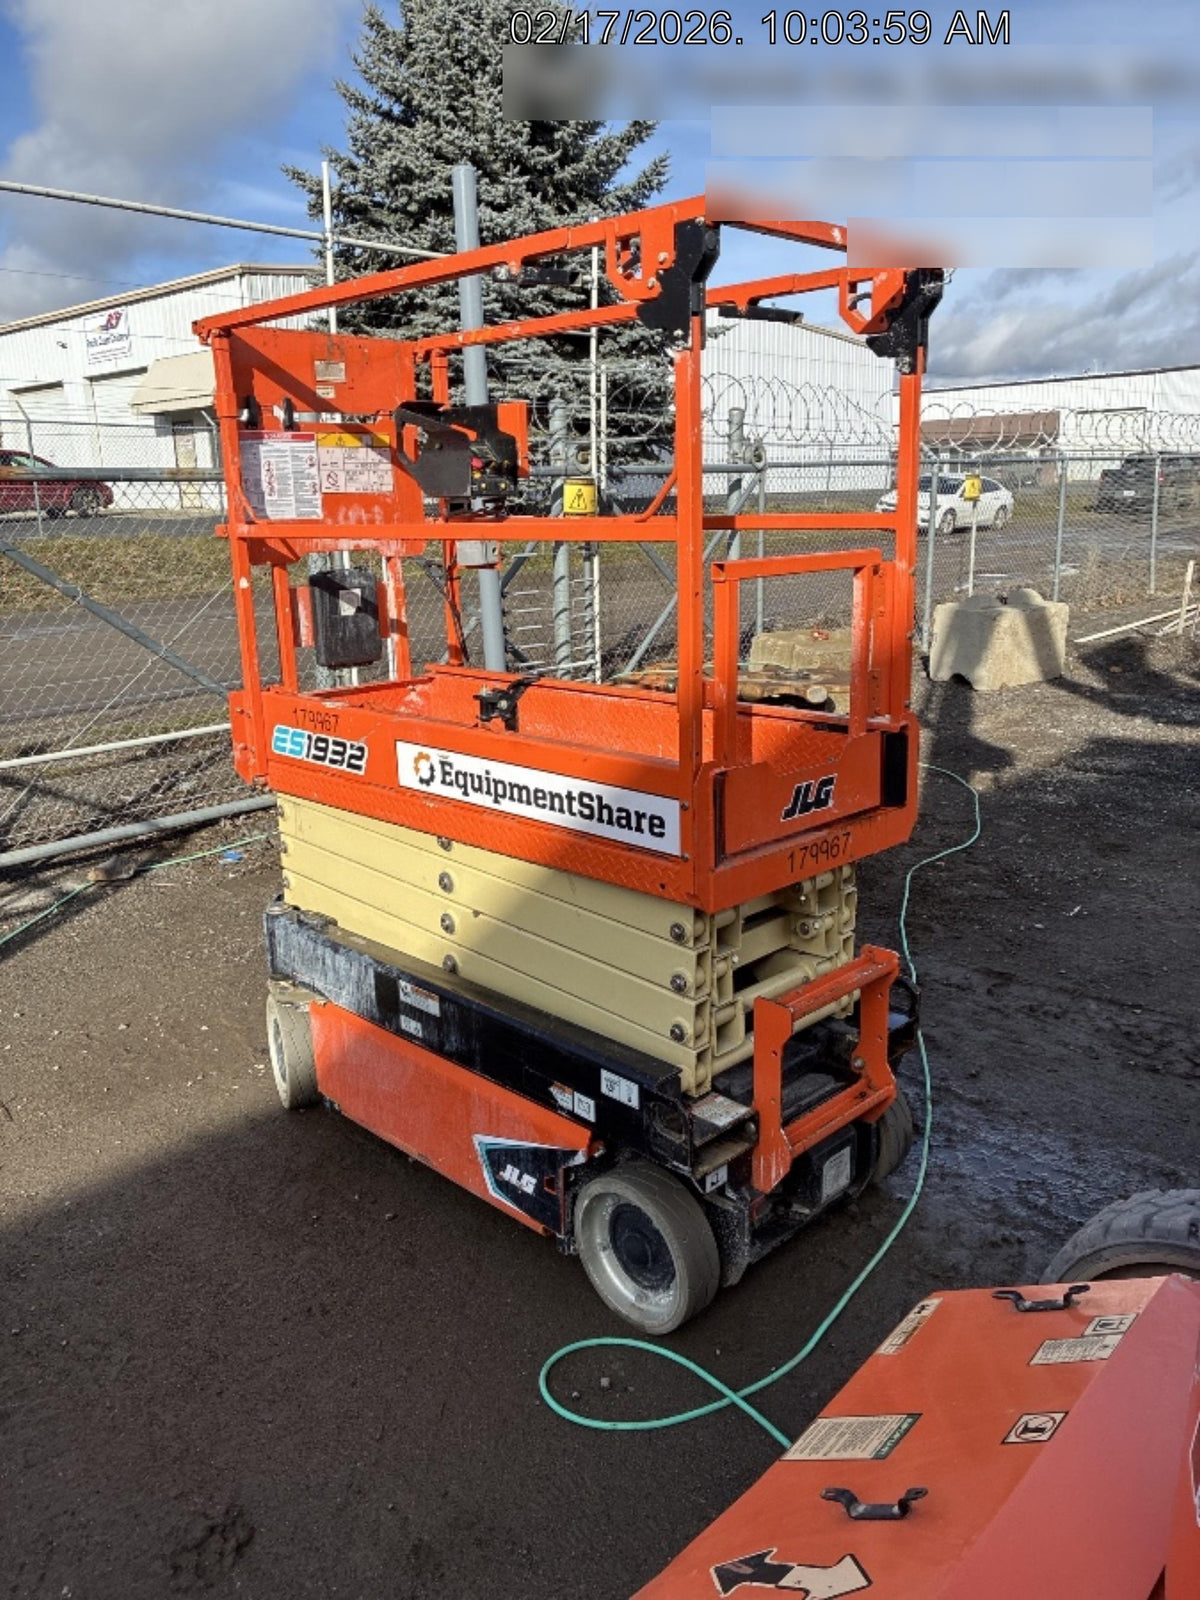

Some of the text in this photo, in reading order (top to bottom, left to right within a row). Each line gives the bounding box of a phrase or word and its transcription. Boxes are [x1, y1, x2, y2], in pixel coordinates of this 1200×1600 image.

[293, 707, 339, 732] 179967
[273, 726, 366, 772] ES1932
[439, 758, 666, 839] EquipmentShare
[781, 773, 838, 821] JLG
[788, 831, 851, 874] 179967
[498, 1163, 538, 1196] JLG
